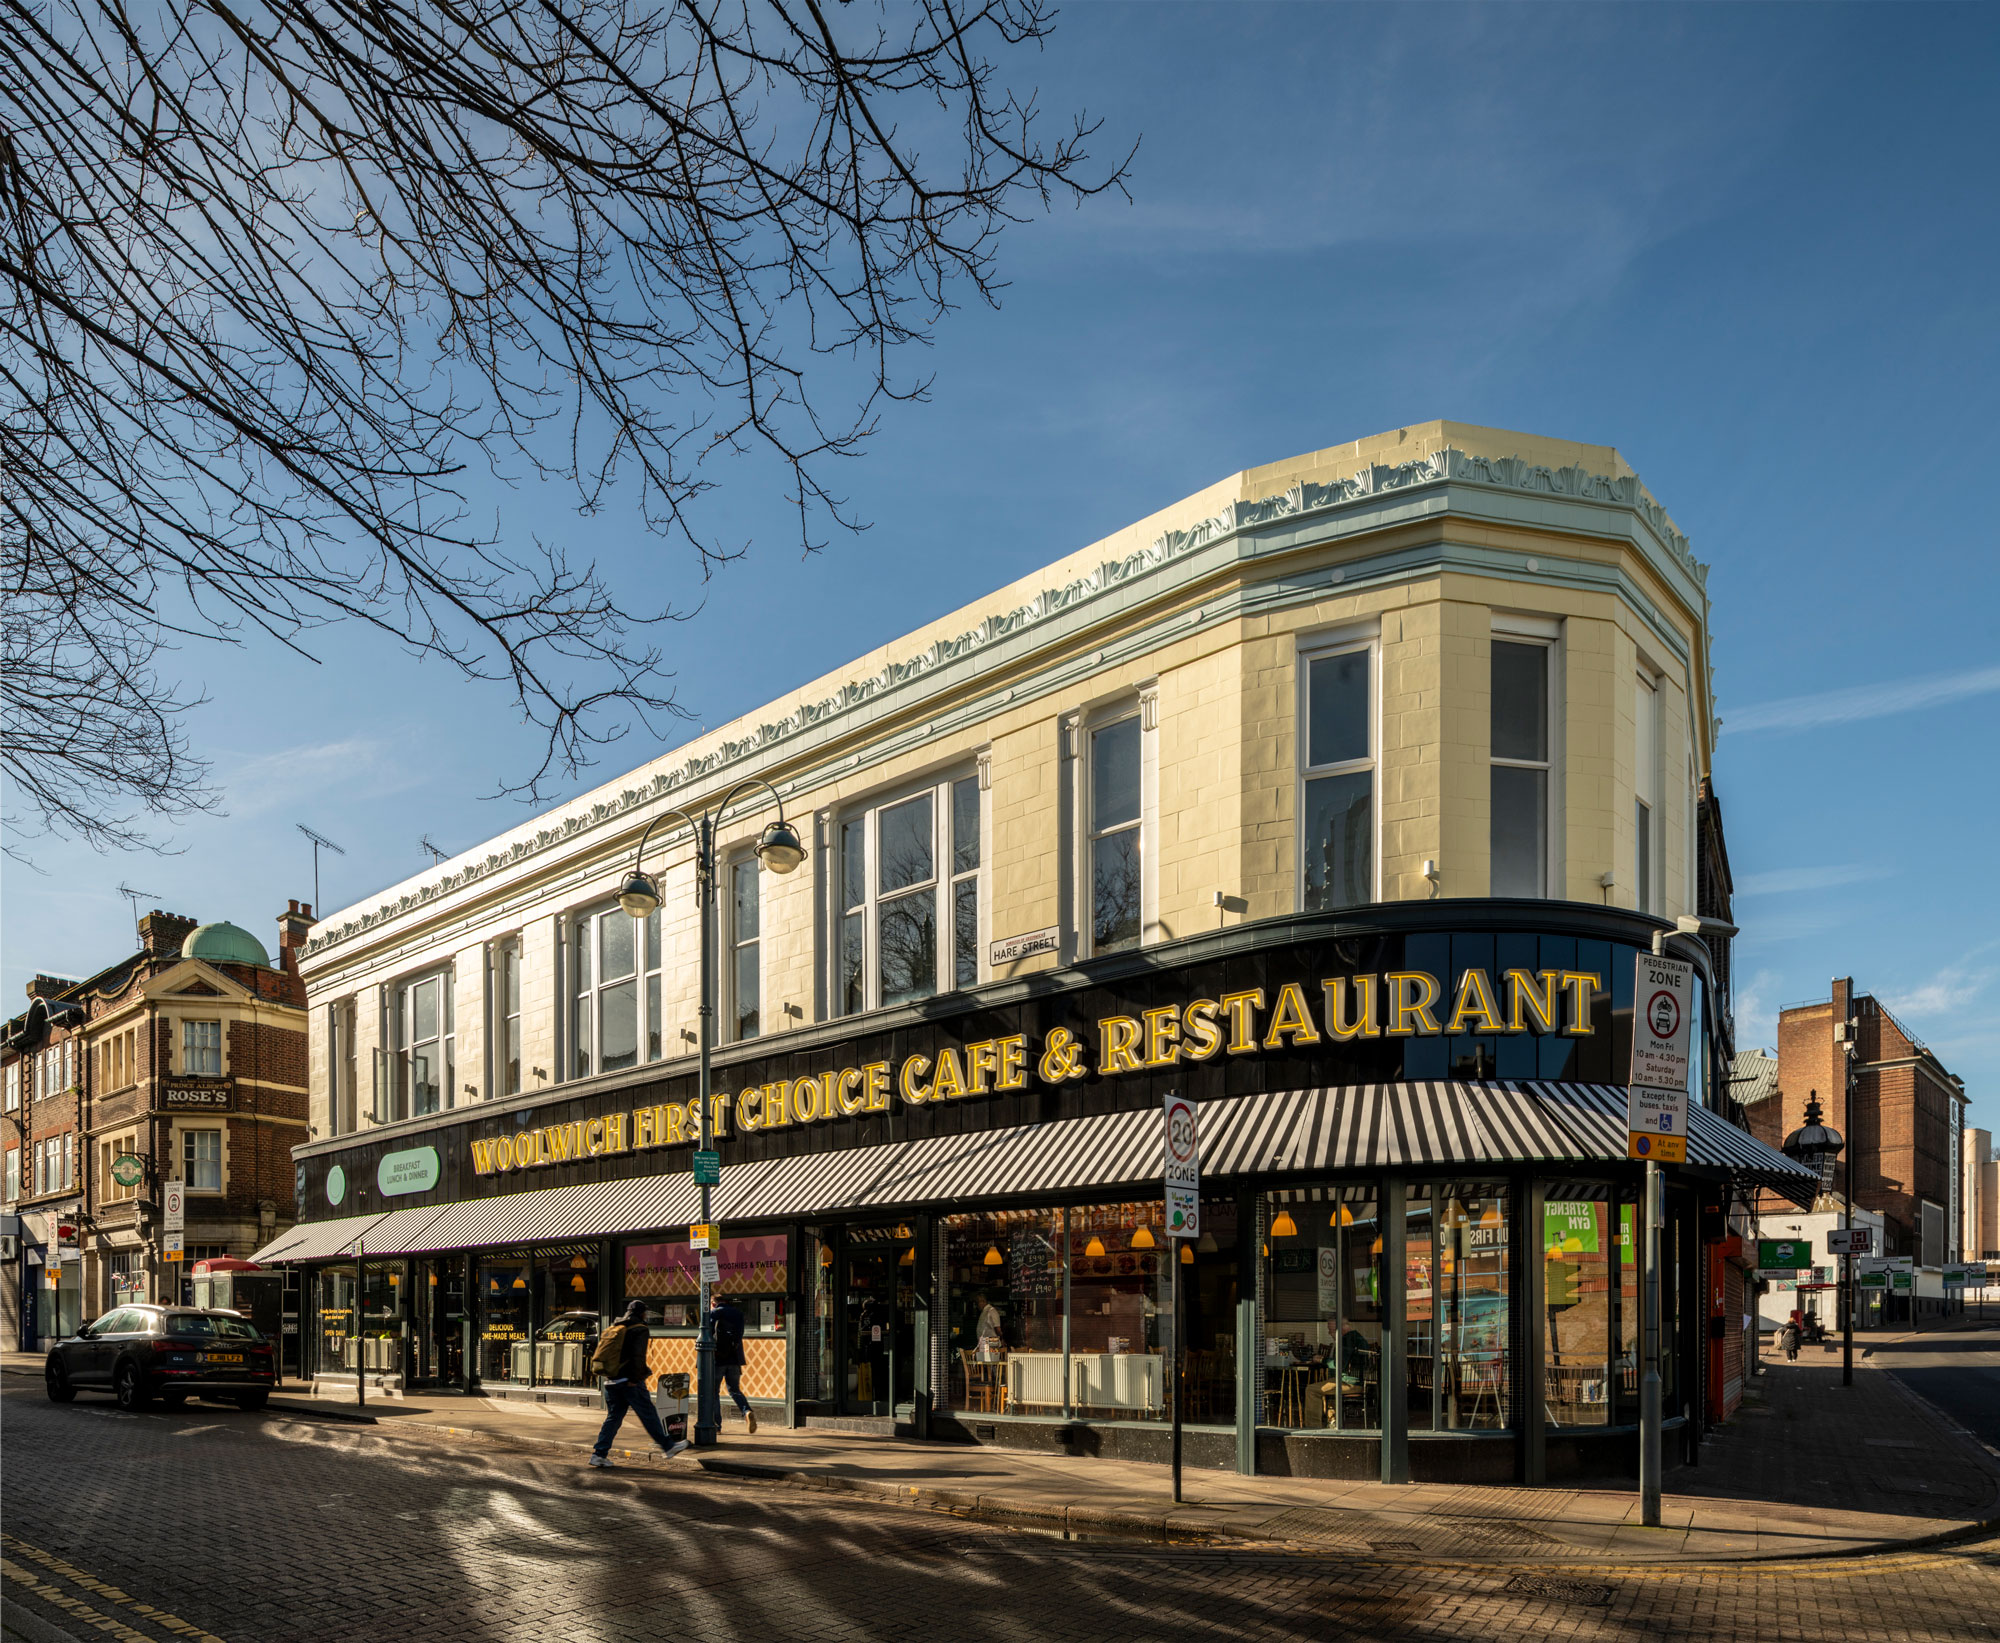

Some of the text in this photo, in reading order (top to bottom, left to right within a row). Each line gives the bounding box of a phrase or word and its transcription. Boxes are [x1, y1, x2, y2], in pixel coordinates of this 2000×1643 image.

[994, 936, 1056, 960] HARE STREET
[1644, 958, 1688, 973] PEDESTRIAN
[1649, 970, 1681, 988] ZONE
[1650, 1041, 1674, 1051] Mon Fri
[1636, 1049, 1644, 1058] 10
[1659, 1053, 1675, 1063] 4.30
[1676, 1057, 1686, 1065] pm
[471, 968, 1601, 1175] WOOLWICH FIRST CHOICE CAFE & RESTAURANT
[1646, 1063, 1675, 1076] Saturday
[1658, 1076, 1674, 1085] 5.30
[167, 1090, 227, 1102] ROSE'S
[1642, 1091, 1677, 1102] Except for
[1663, 1103, 1678, 1111] taxis
[1172, 1119, 1192, 1145] 20
[1661, 1149, 1675, 1157] time
[394, 1160, 420, 1172] BREAKFAST
[387, 1170, 428, 1184] LUNCH & DINNER
[1169, 1165, 1195, 1182] ZONE
[1854, 1232, 1864, 1242] H
[1036, 1284, 1052, 1294] £9.90
